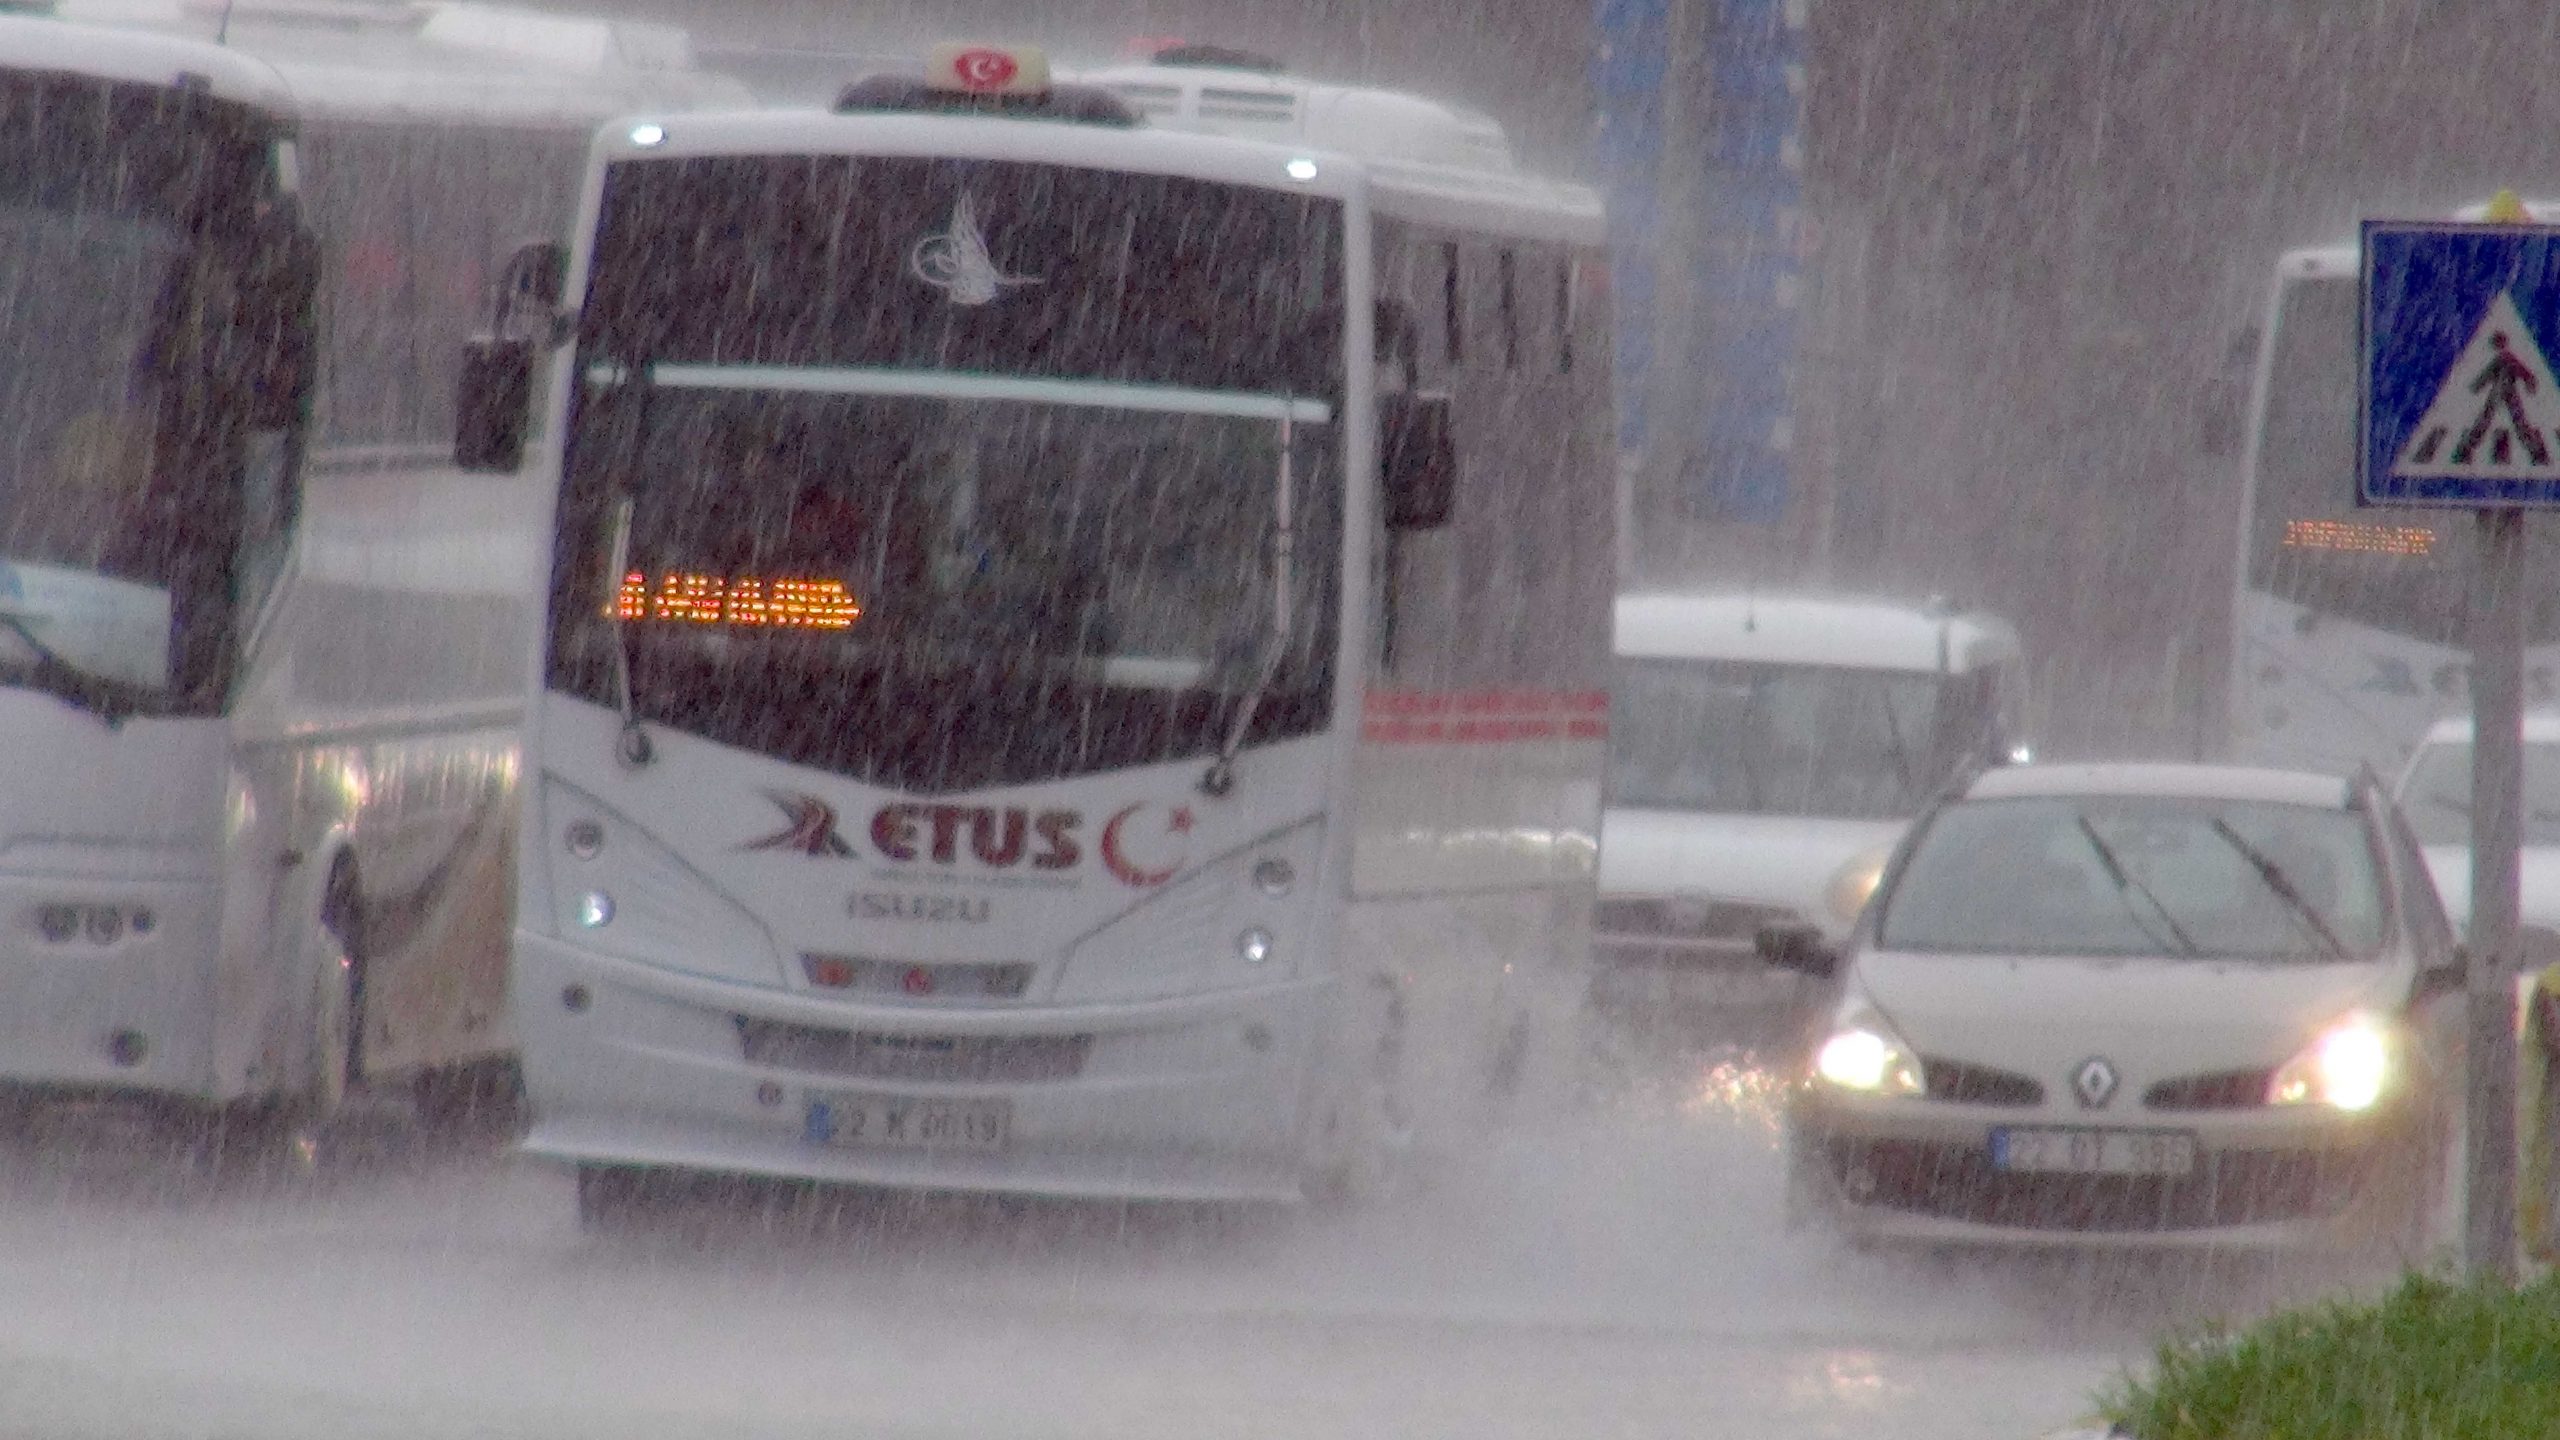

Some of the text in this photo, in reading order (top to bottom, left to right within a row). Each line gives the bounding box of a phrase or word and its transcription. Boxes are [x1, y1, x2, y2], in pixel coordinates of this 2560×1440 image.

[870, 803, 1082, 870] ETUS
[845, 893, 991, 923] ISUZU
[887, 1109, 907, 1140] K
